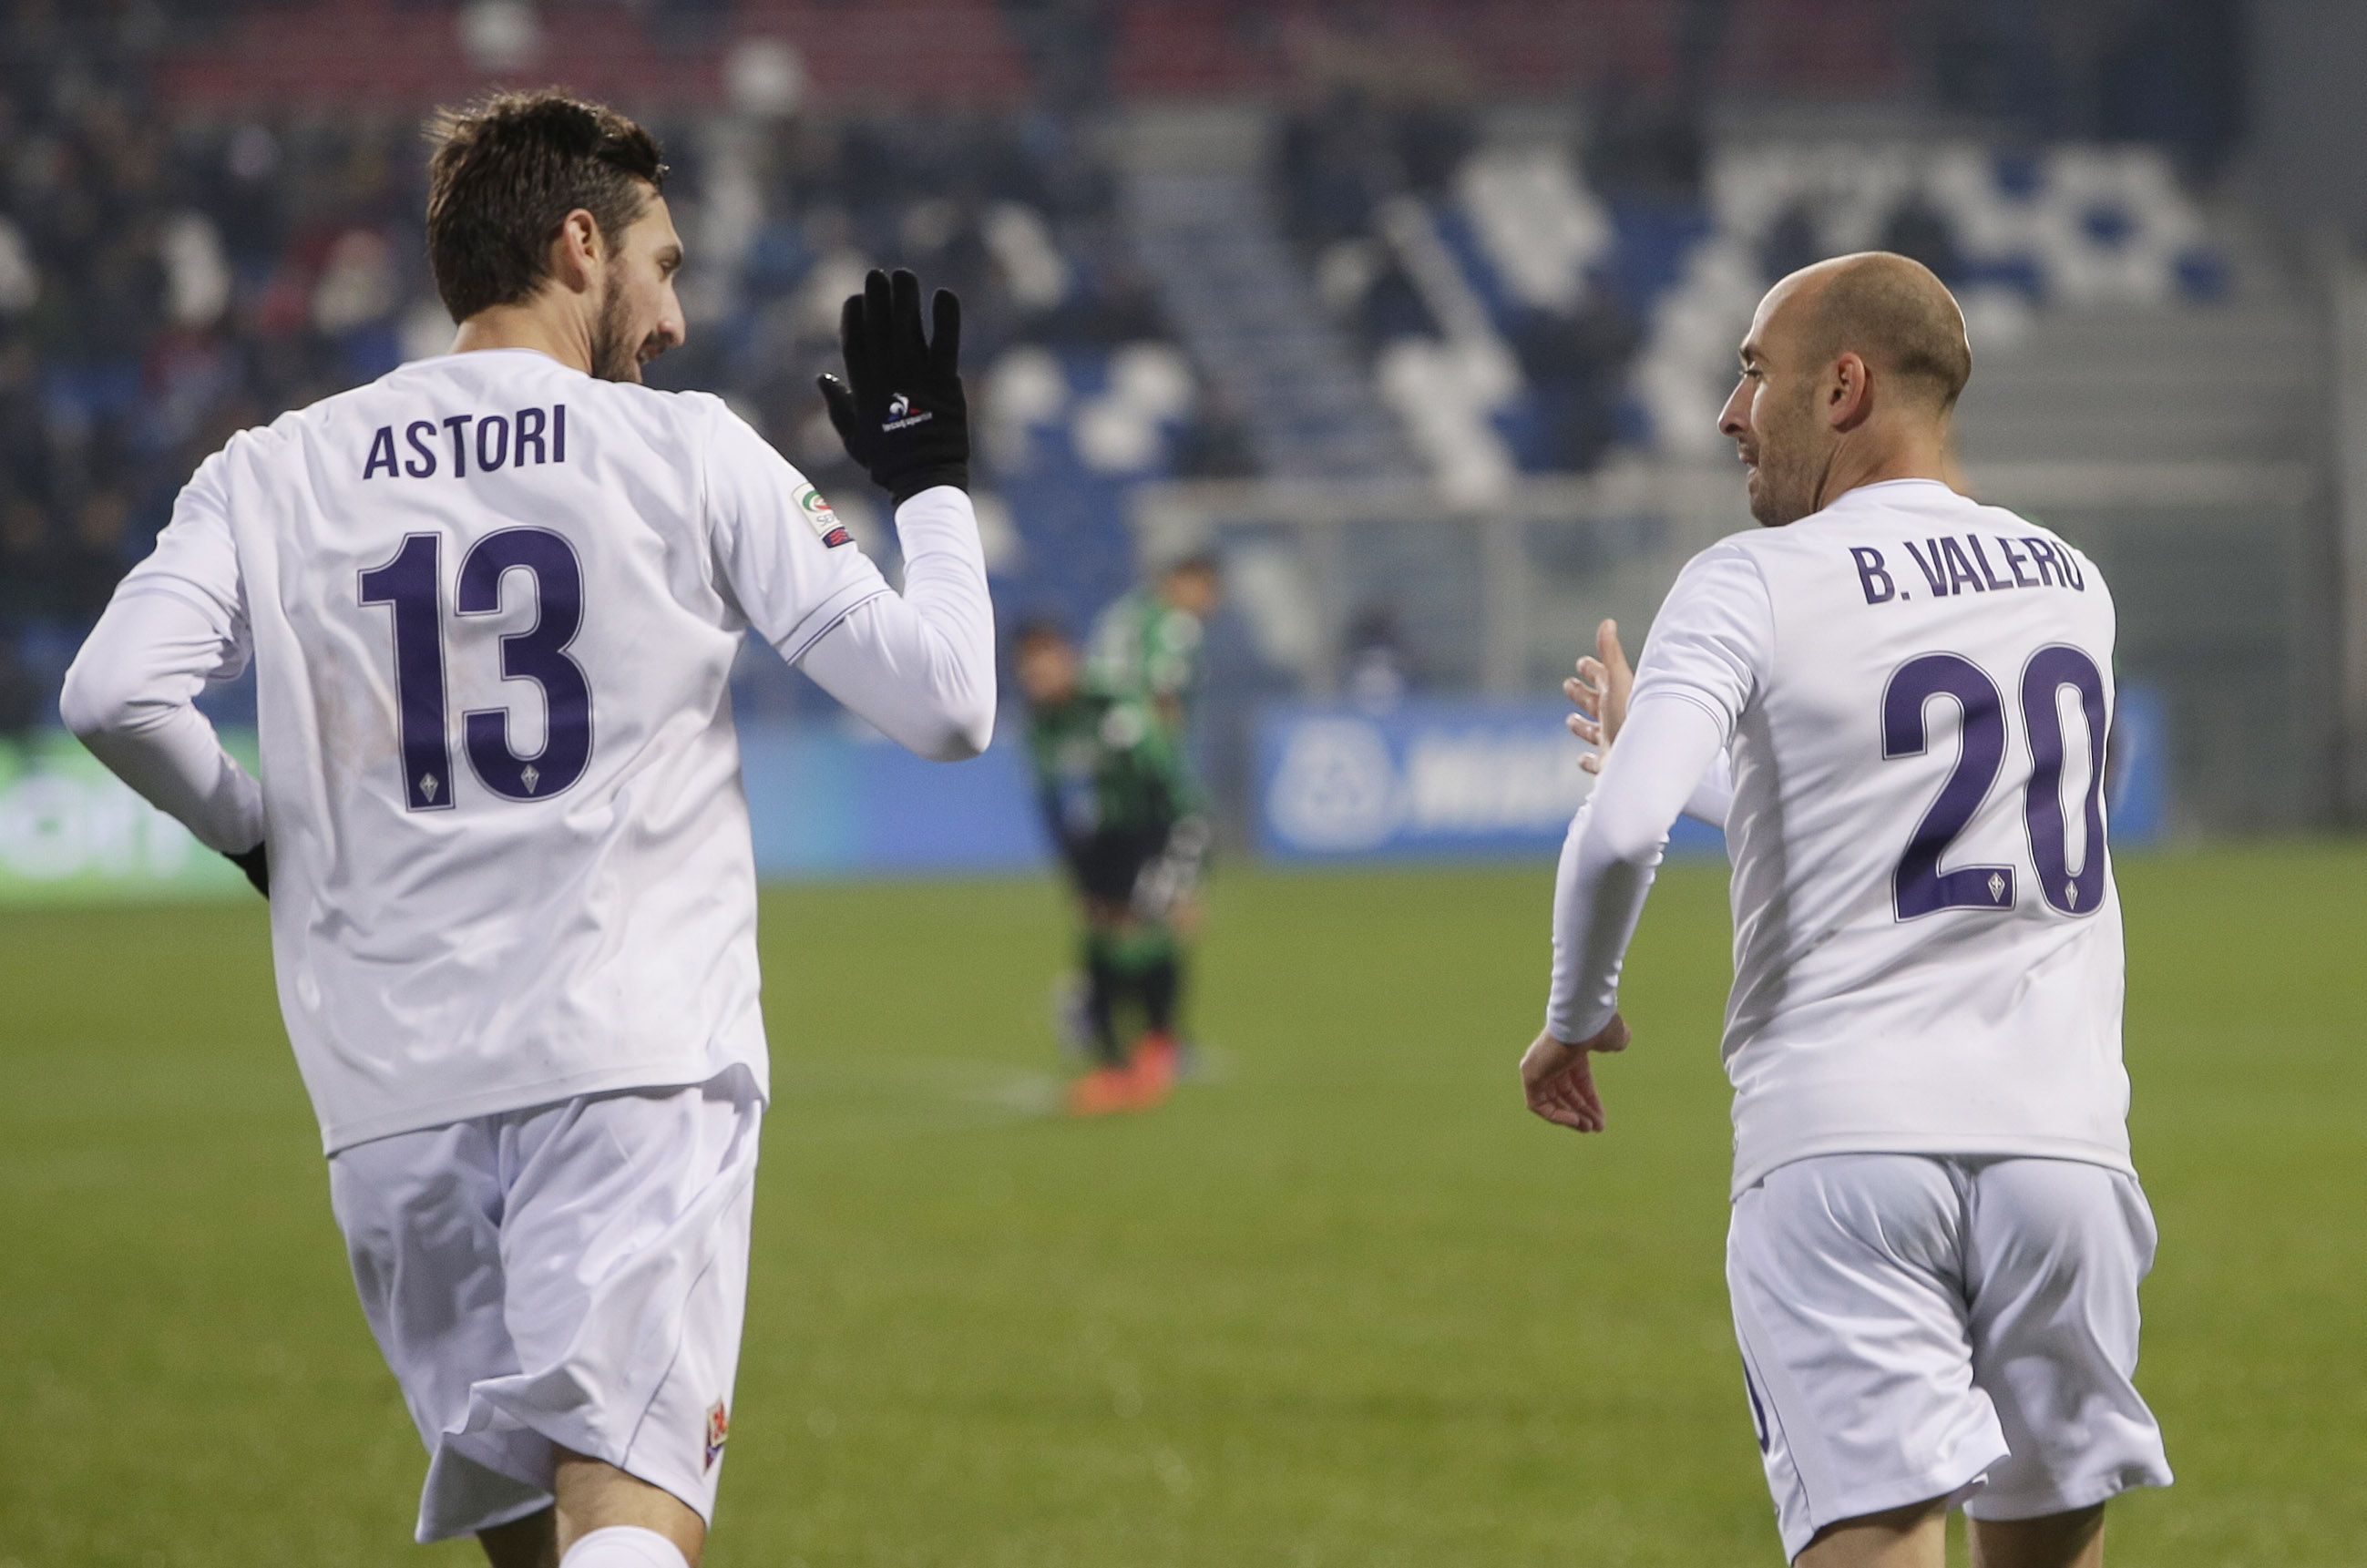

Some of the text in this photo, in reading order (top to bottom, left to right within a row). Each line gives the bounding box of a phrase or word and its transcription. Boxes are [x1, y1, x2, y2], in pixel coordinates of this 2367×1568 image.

[363, 405, 566, 480] ASTORI
[1849, 533, 2085, 605] B. VALERO
[357, 526, 594, 813] 13
[1880, 642, 2106, 923] 20
